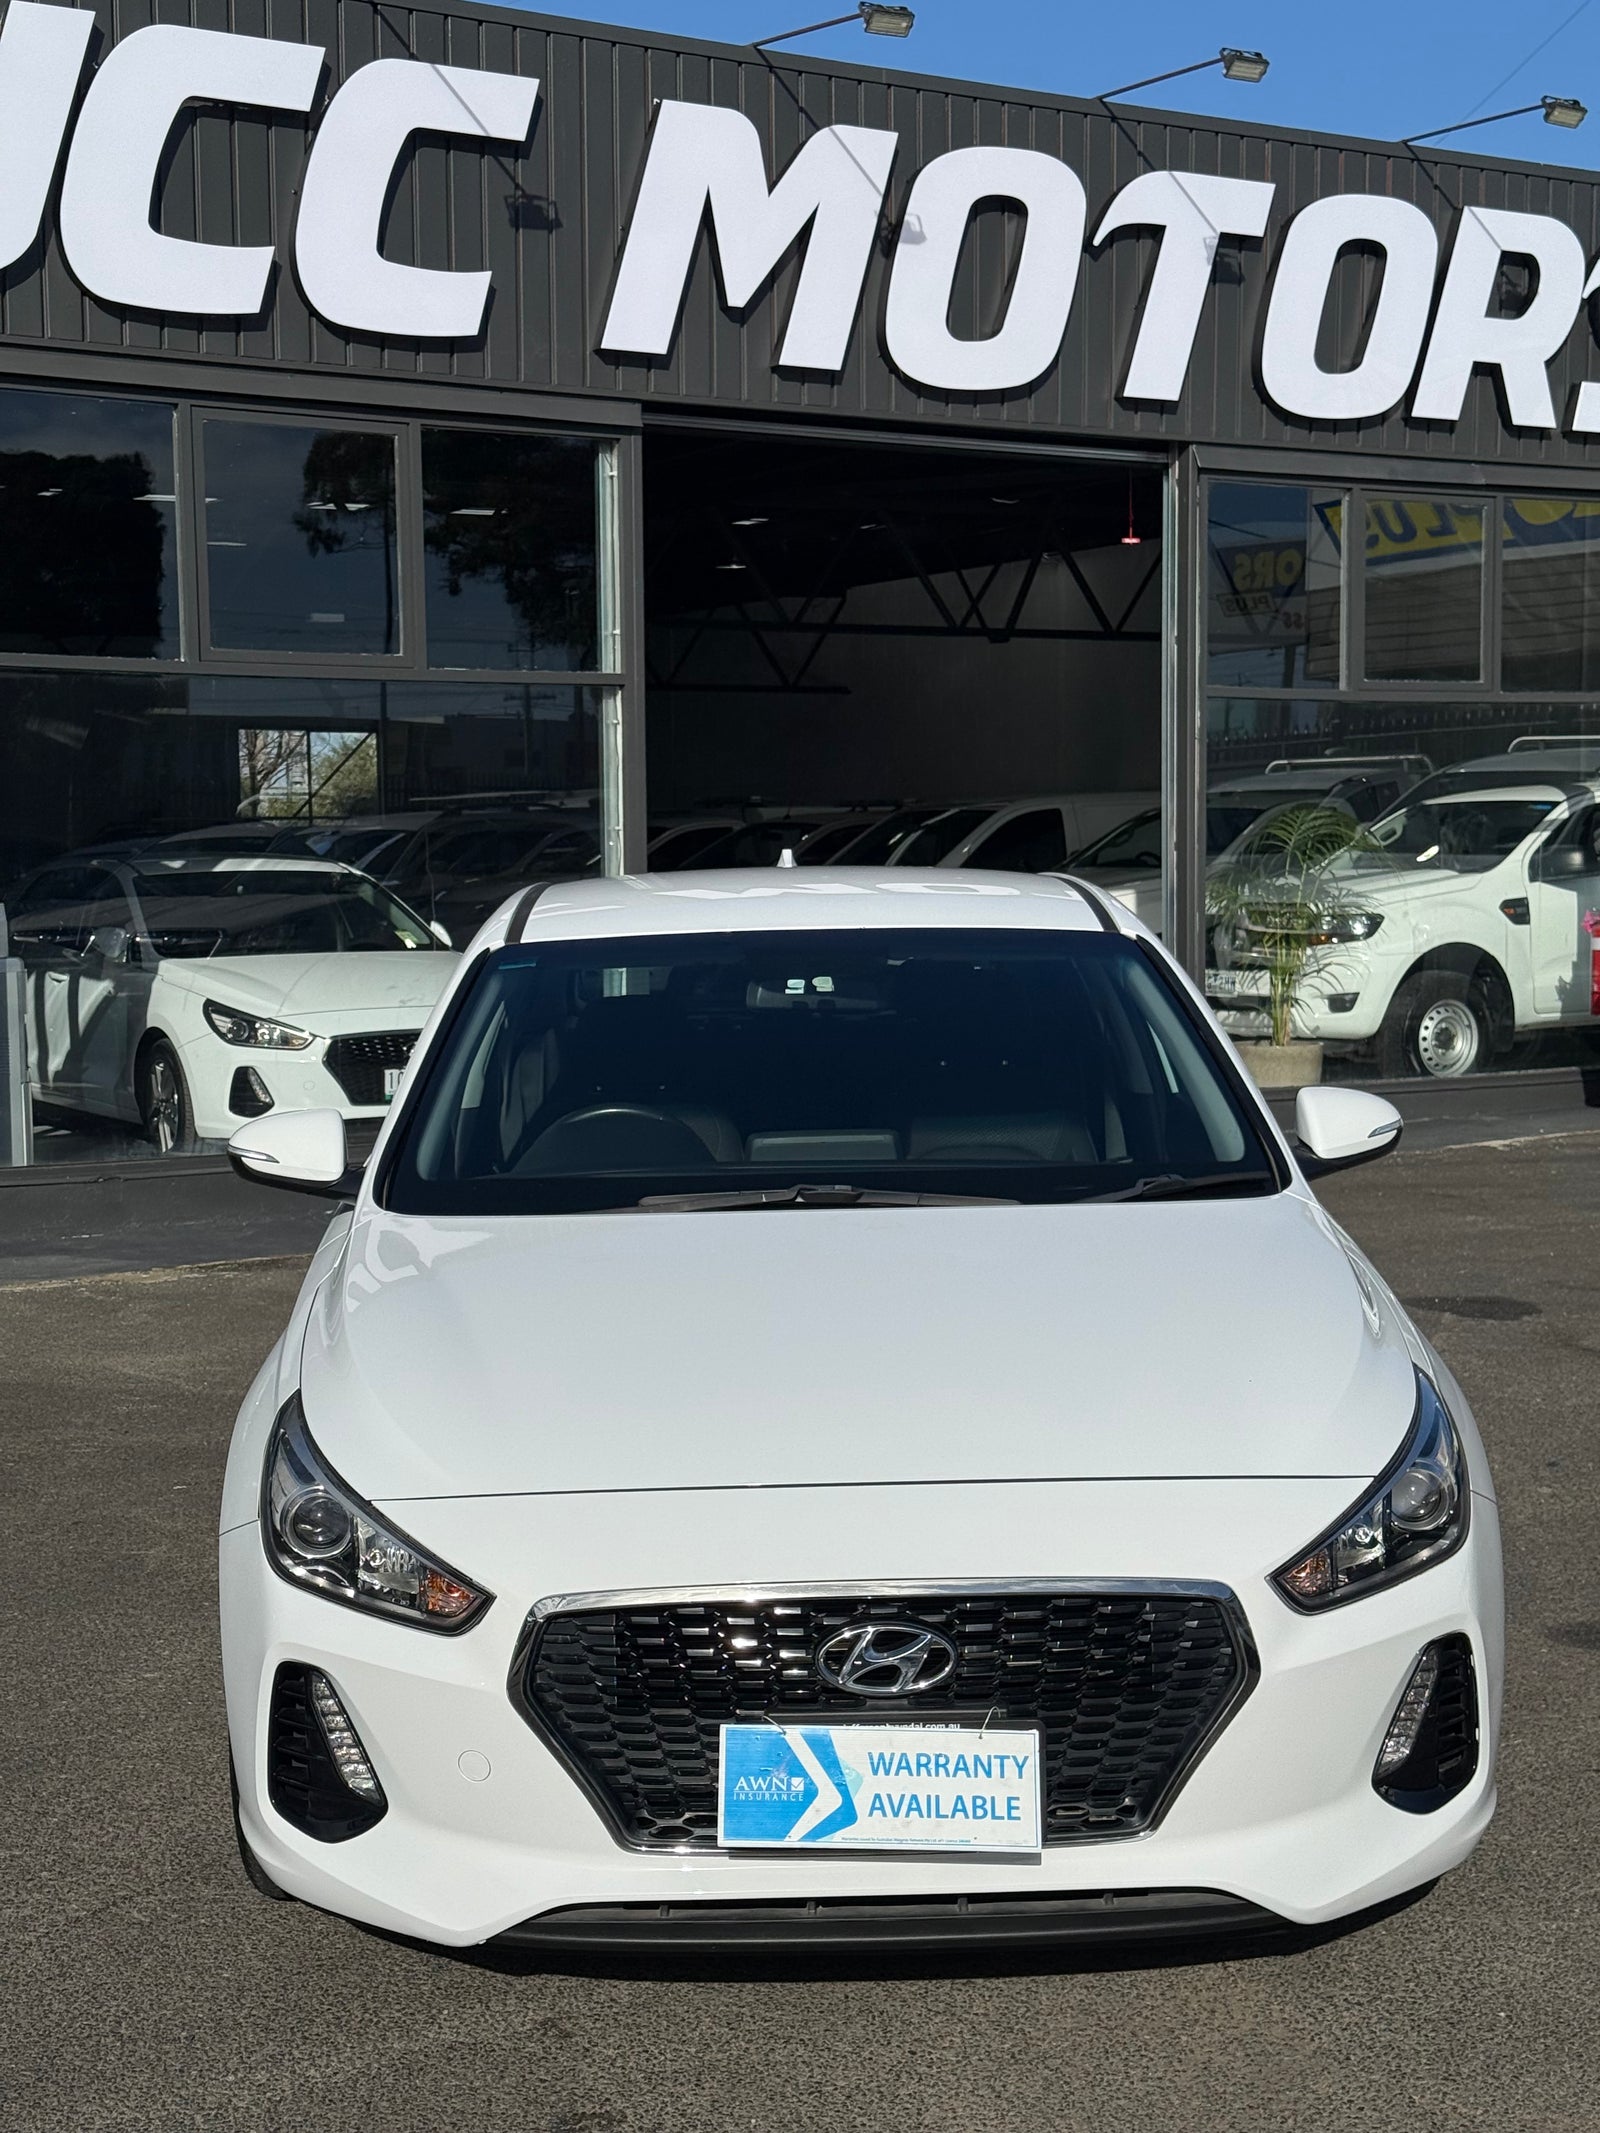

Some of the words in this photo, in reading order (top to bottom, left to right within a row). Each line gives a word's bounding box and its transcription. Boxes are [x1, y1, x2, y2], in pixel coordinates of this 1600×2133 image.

[600, 98, 1600, 432] MOTOR
[867, 1751, 1029, 1780] WARRANTY
[733, 1775, 788, 1791] AWN
[733, 1792, 804, 1802] INSURANCE
[867, 1792, 1022, 1821] AVAILABLE
